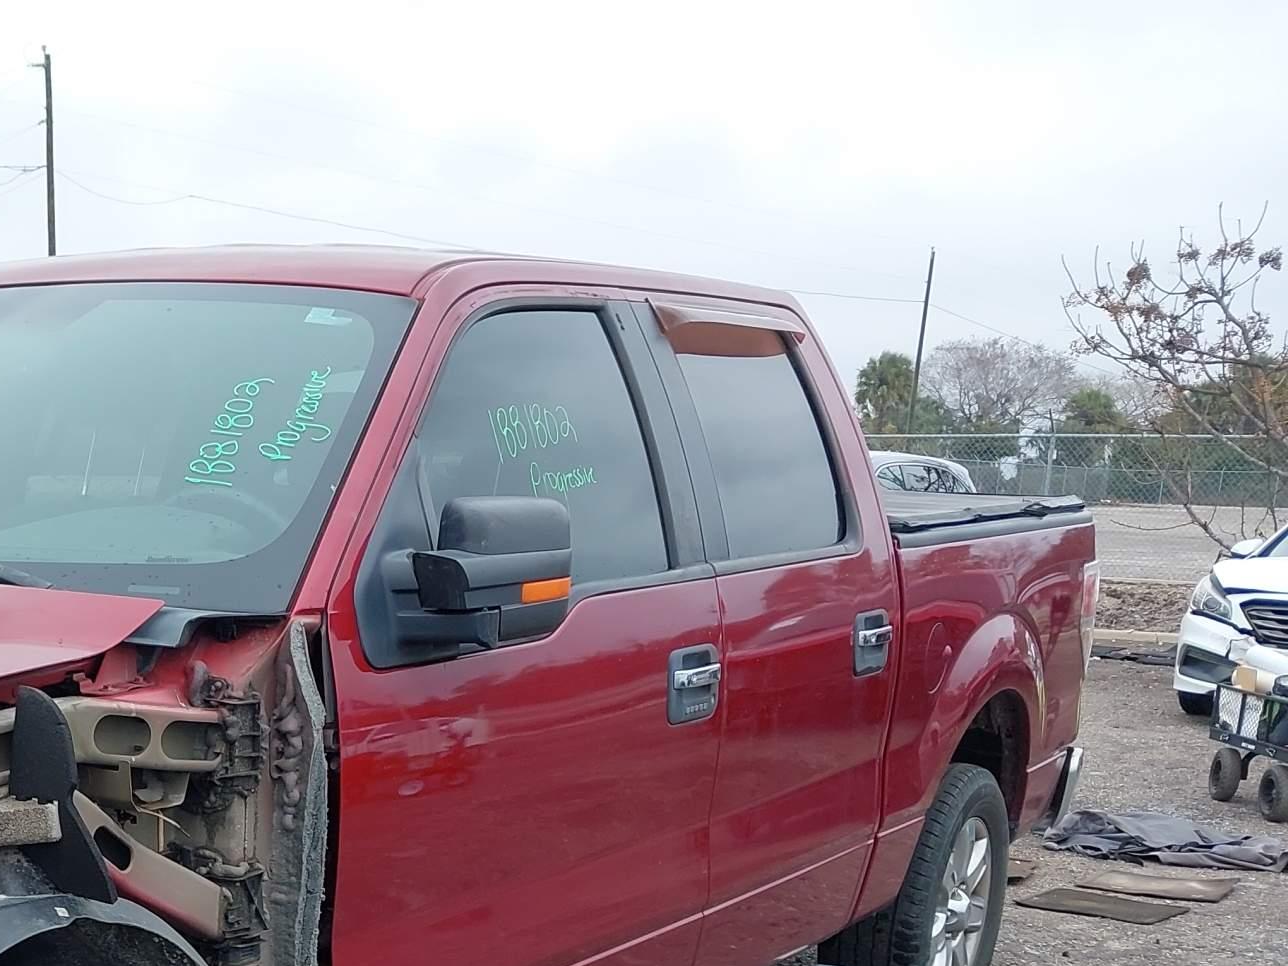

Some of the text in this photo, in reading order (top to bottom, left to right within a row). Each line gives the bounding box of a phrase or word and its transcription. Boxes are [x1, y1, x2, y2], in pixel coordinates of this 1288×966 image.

[184, 378, 275, 487] 1881802
[259, 366, 331, 460] Progressive
[488, 403, 578, 464] 1881802
[530, 462, 597, 498] Progressive
